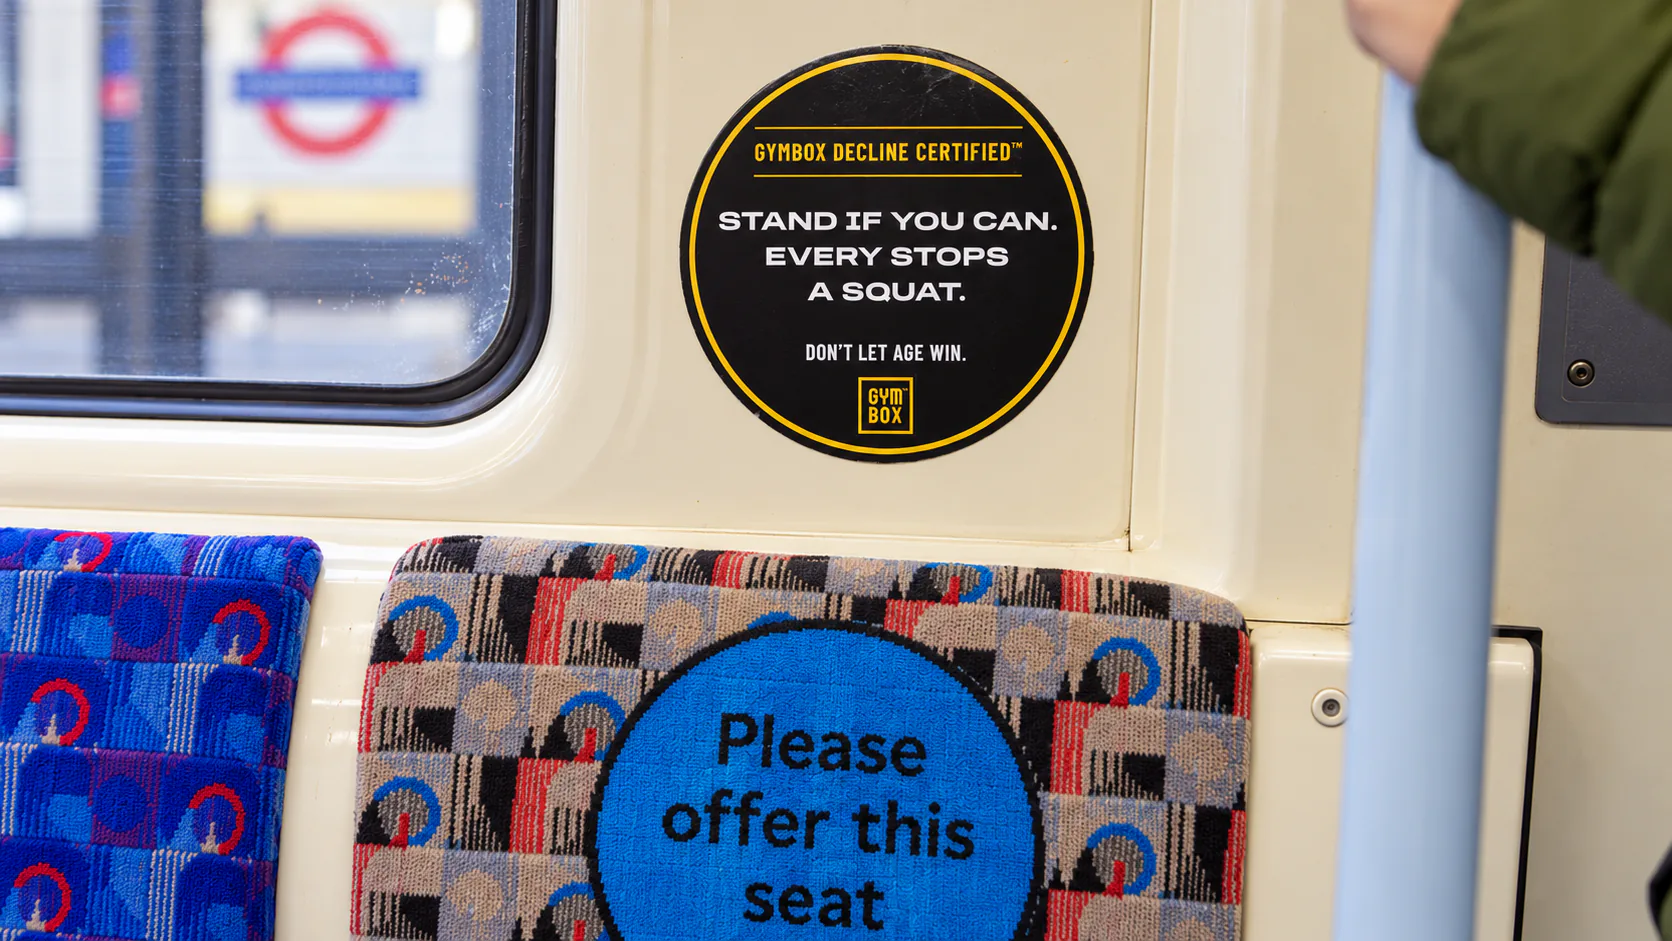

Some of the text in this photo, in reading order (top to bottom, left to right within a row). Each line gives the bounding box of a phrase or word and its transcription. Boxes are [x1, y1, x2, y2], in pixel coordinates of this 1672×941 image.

[754, 142, 827, 162] GYMBOX
[833, 142, 909, 162] DECLINE
[718, 211, 1058, 231] STAND IF YOU CAN.
[765, 246, 1009, 267] EVERY STOPS
[807, 281, 966, 303] A SQUAT.
[805, 343, 967, 362] DON’T LET AGE WIN.
[868, 406, 902, 425] BOX
[717, 712, 927, 776] Please
[661, 787, 975, 861] offer this
[742, 880, 885, 932] seat
